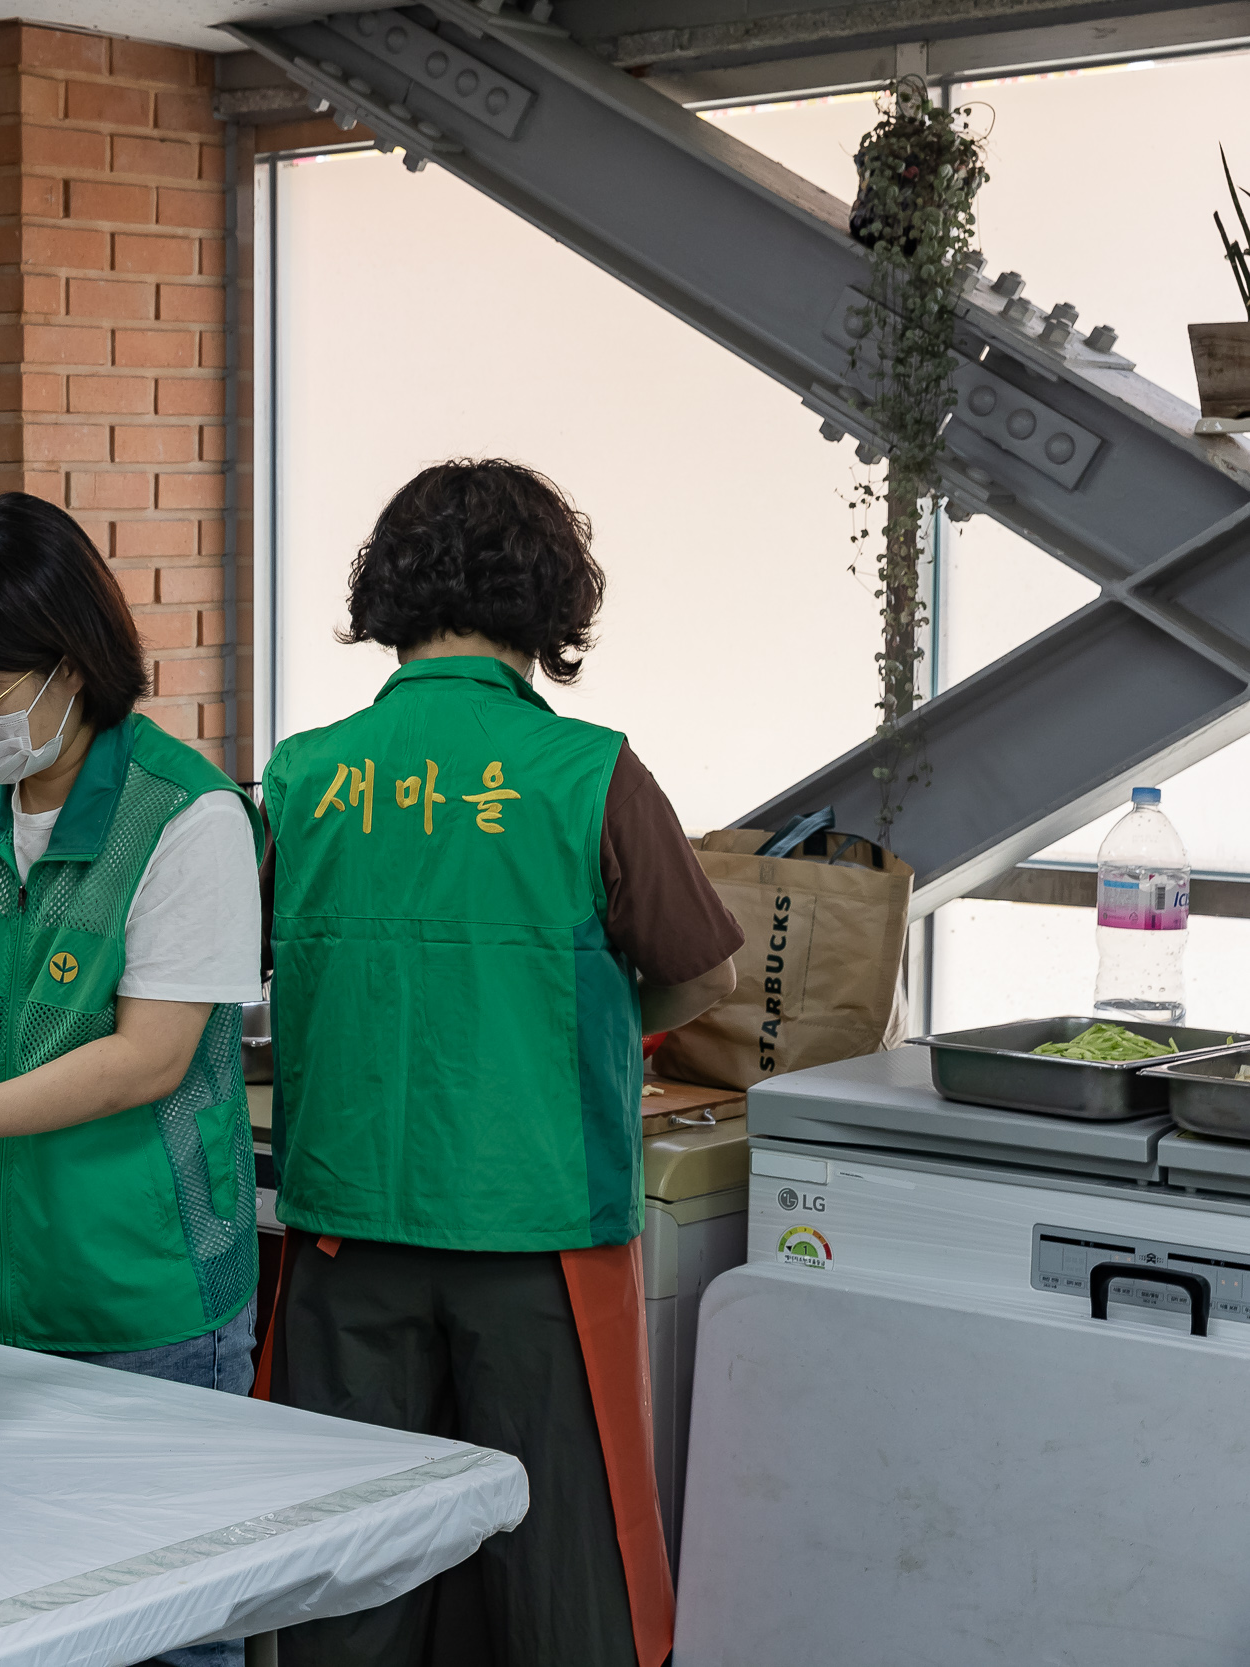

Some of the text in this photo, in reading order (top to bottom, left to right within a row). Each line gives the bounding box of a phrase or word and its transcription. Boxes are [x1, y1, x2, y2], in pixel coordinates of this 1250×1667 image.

[314, 758, 521, 835] 새마을
[759, 894, 792, 1073] STARBUCKS
[802, 1194, 826, 1212] LG
